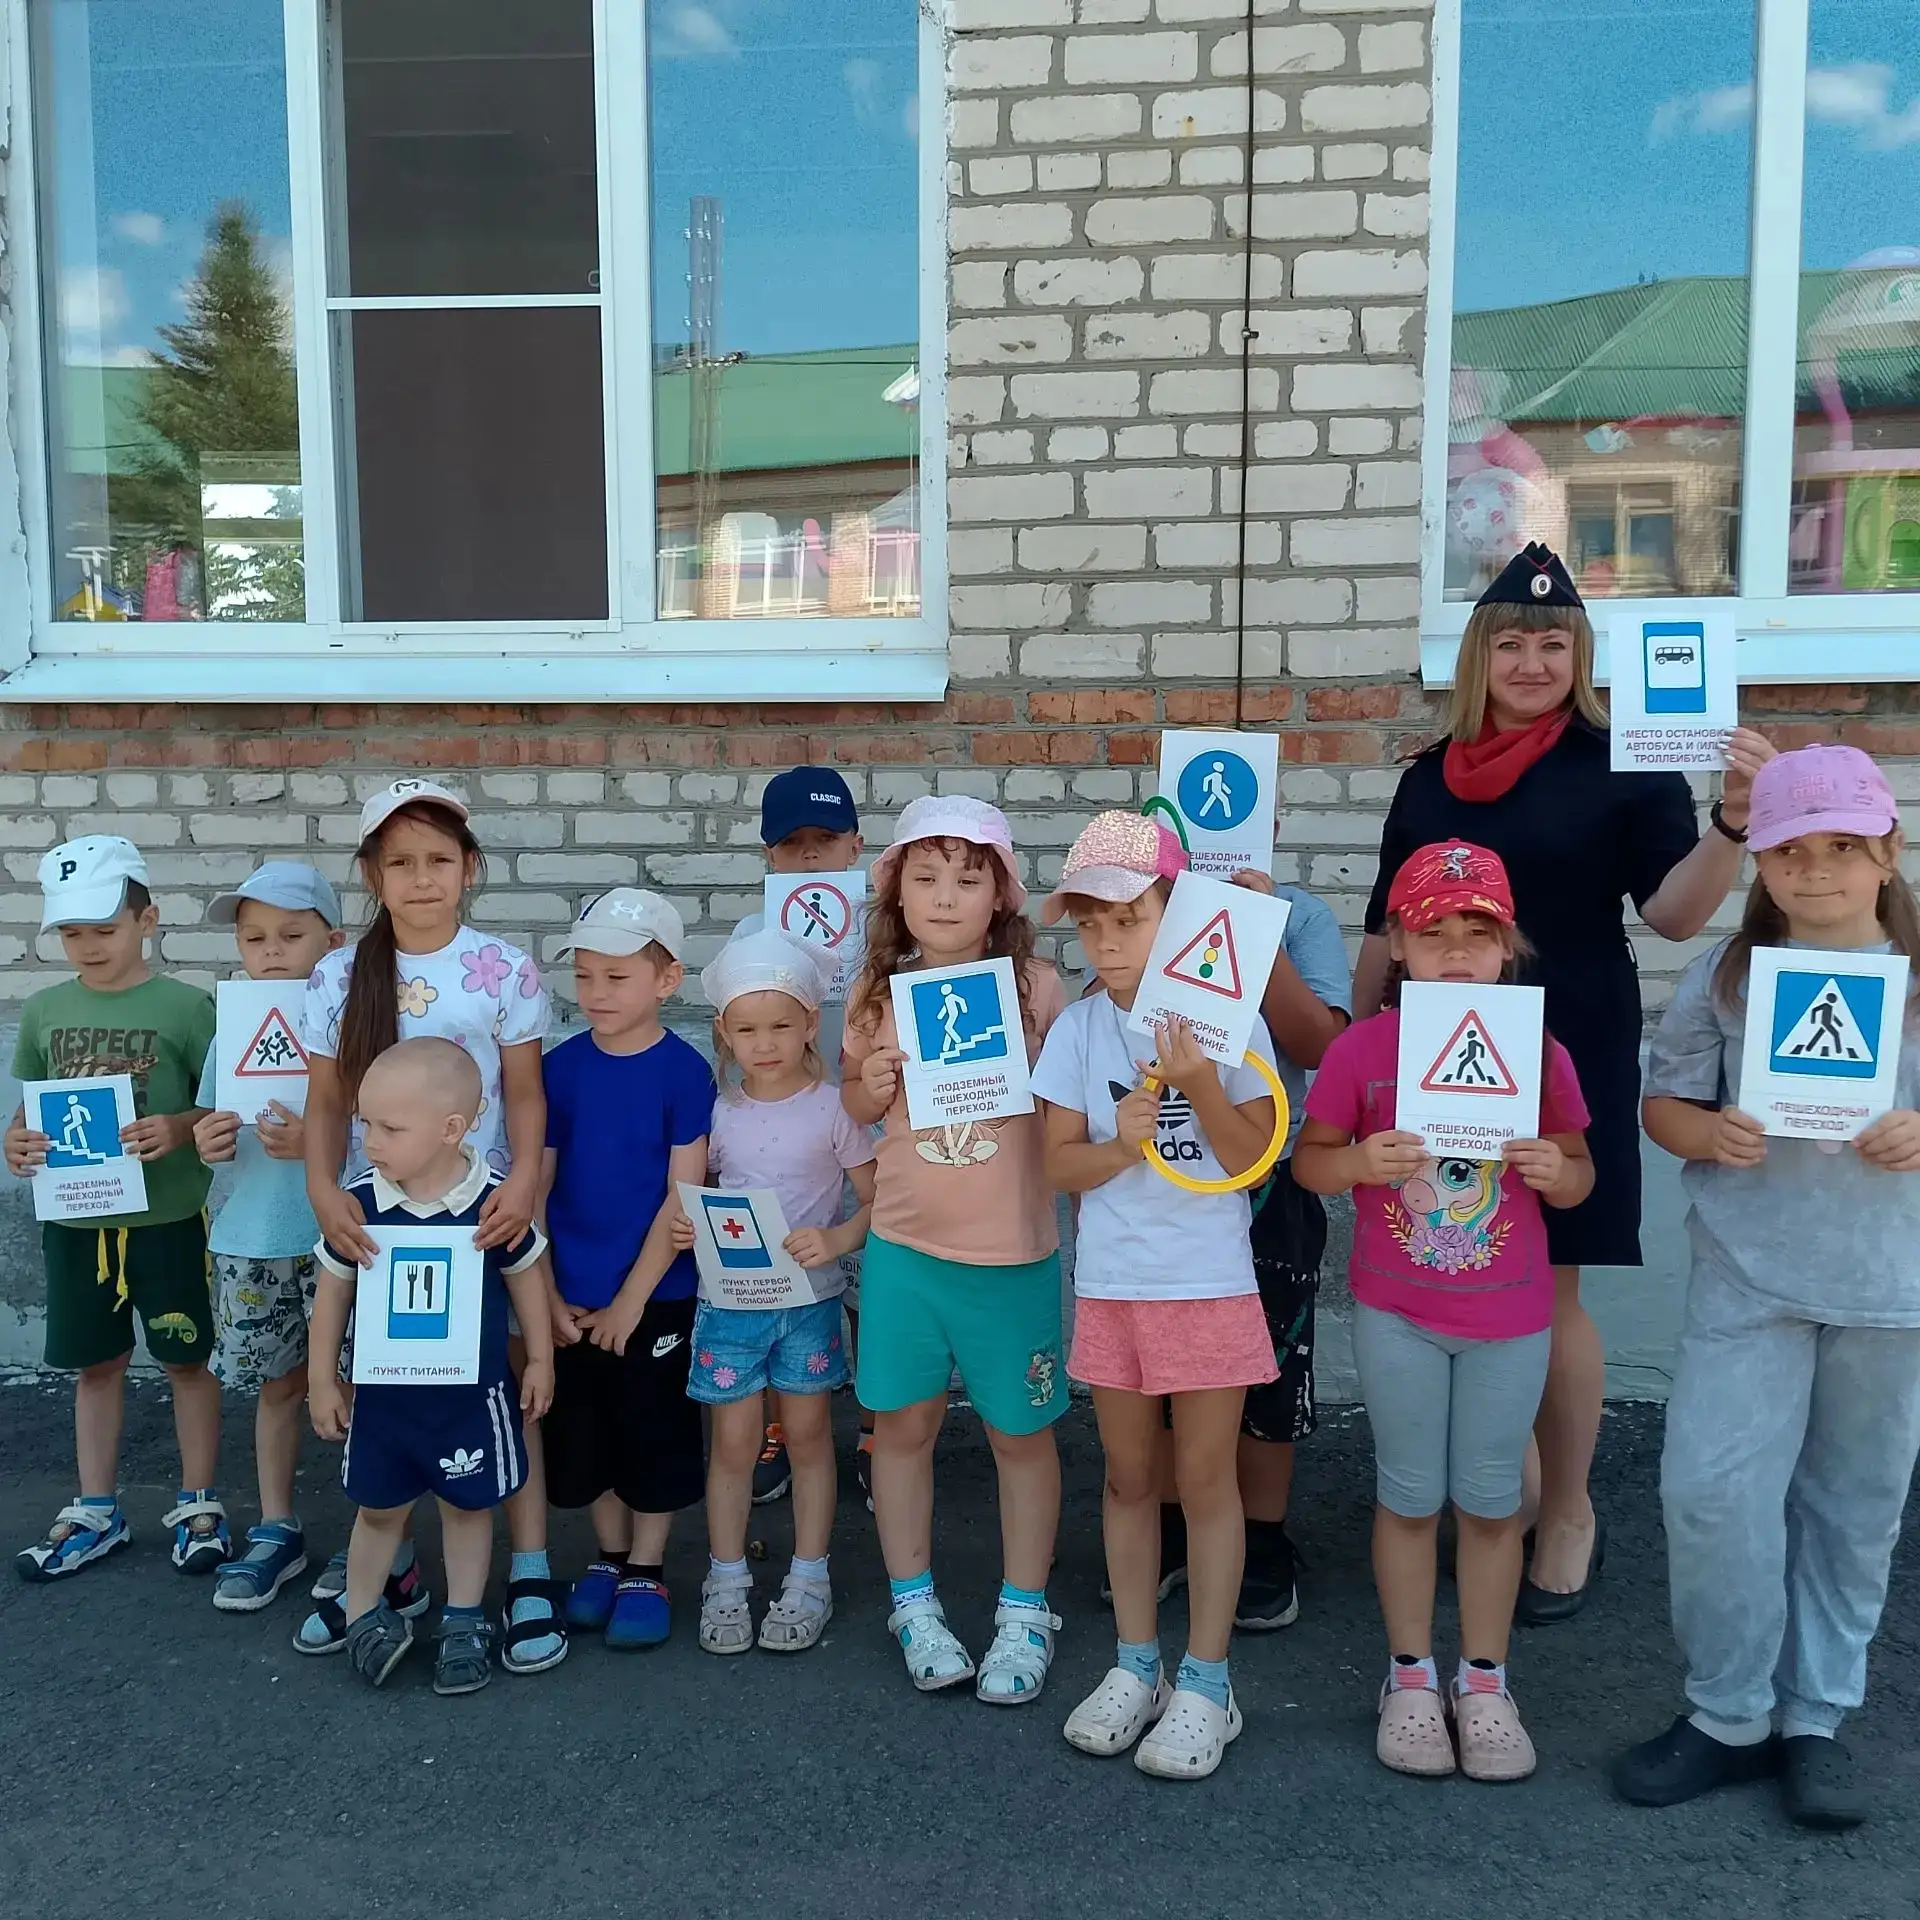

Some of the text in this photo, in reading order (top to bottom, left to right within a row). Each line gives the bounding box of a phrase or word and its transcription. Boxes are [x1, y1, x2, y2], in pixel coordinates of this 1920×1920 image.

[1625, 741, 1682, 751] АВТОБУСА
[1686, 741, 1694, 750] И
[810, 792, 842, 805] CLASSIC
[1189, 851, 1252, 863] ЕШЕХОДНАЯ
[59, 859, 77, 882] P
[1192, 862, 1243, 873] ОРОЖКА»
[50, 1026, 158, 1067] RESPECT
[932, 1085, 1009, 1107] ПЕШЕХОДНЫЙ
[55, 1187, 124, 1202] ПЕШЕХОДНЫЙ
[752, 1275, 792, 1286] ПЕРВОЙ
[722, 1284, 792, 1296] МЕДИЦИНСКОЙ
[656, 1333, 679, 1348] NIKE
